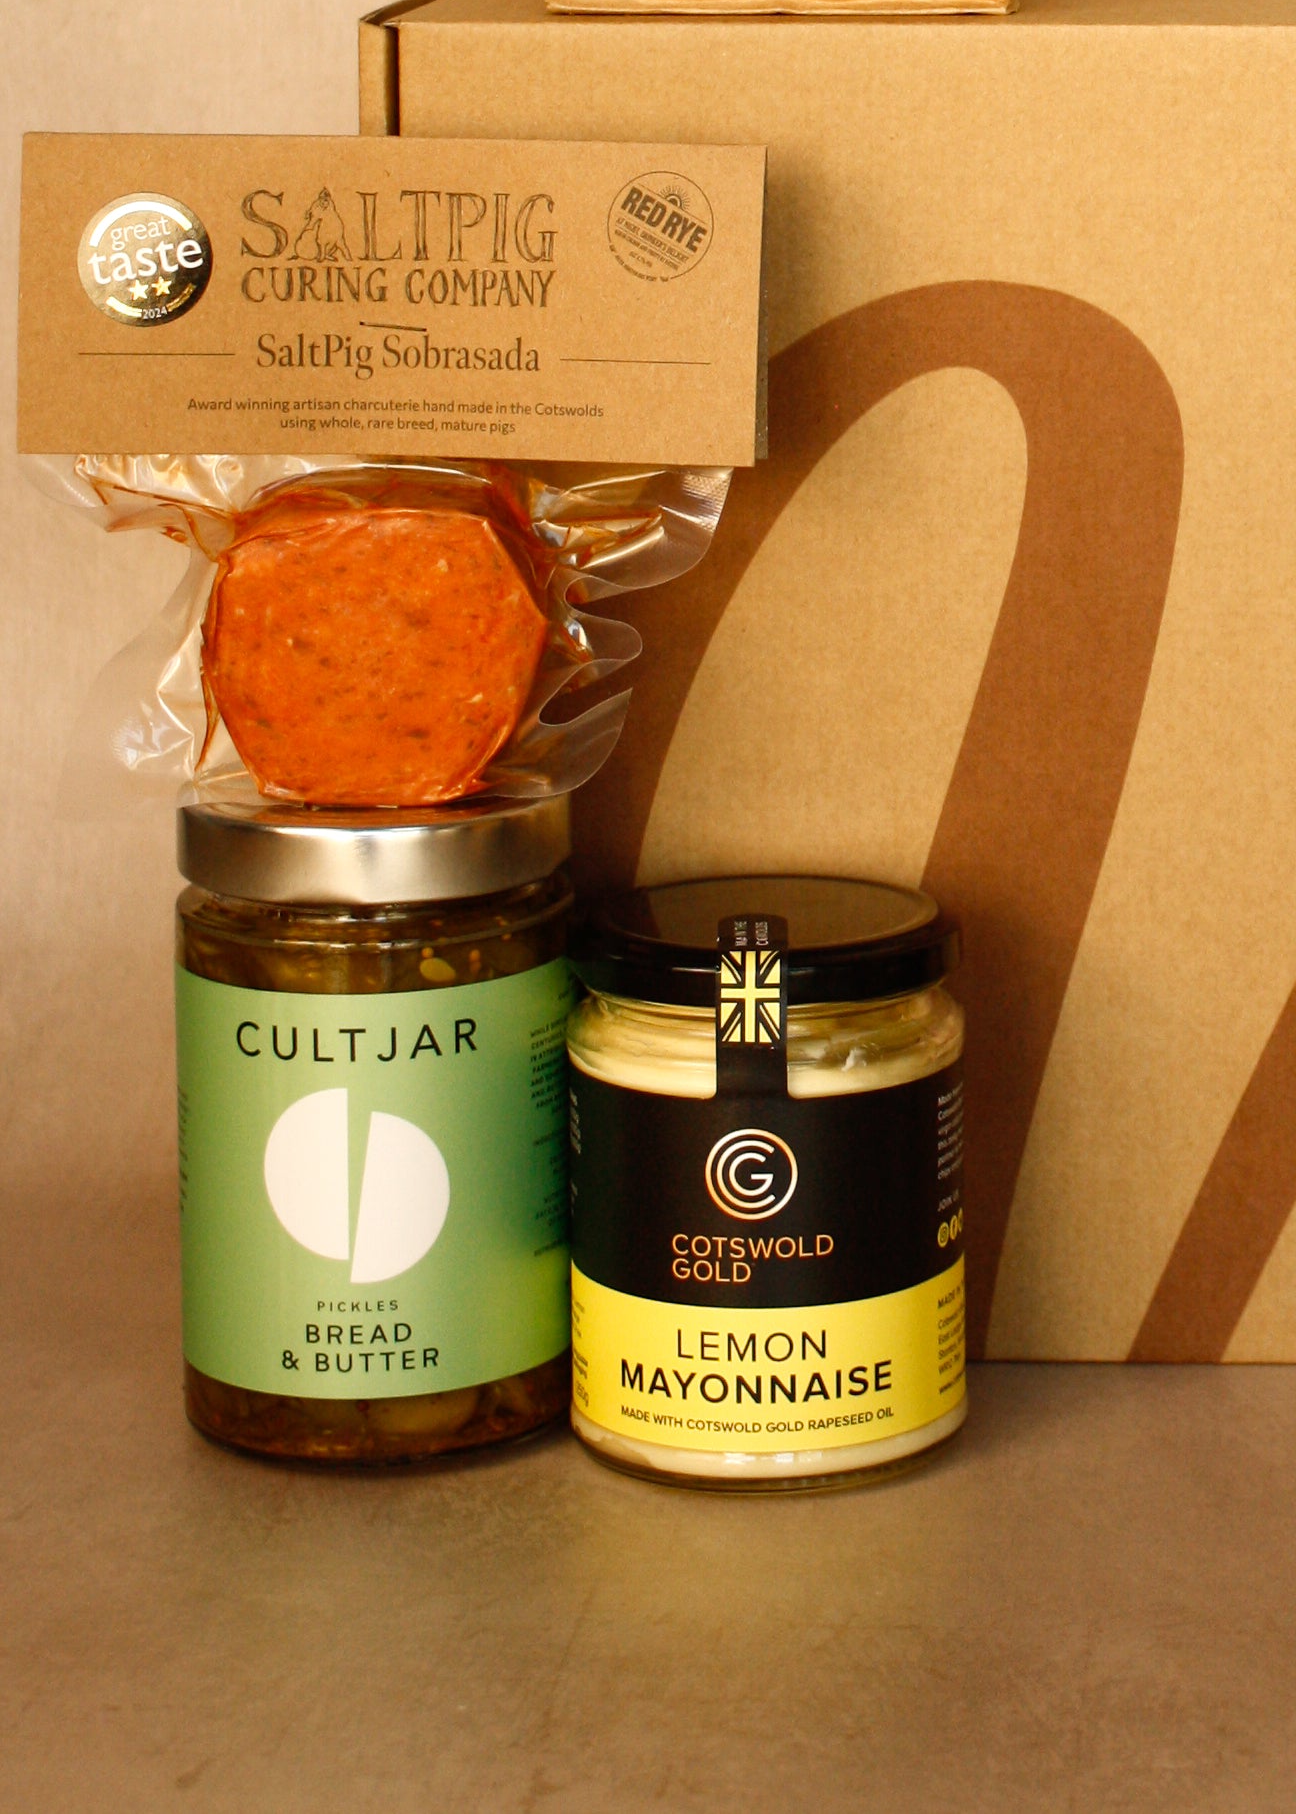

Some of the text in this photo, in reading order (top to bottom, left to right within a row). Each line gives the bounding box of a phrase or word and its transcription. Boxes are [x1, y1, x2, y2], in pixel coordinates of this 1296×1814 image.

[110, 216, 171, 251] great
[621, 186, 667, 227] RED
[661, 210, 707, 253] RYE
[87, 239, 204, 285] taste
[241, 266, 557, 308] CURING COMPANY
[142, 306, 168, 320] 2024
[257, 332, 541, 381] SaltPig Sobrasada
[187, 398, 604, 417] Award winning artisan charcuterie hand made in the Cotswolds
[280, 417, 516, 435] using whole, rare breed, mature pigs
[236, 1018, 478, 1062] CULTJAR
[672, 1233, 834, 1259] COTSWOLD
[672, 1258, 751, 1282] GOLD
[317, 1299, 399, 1312] PICKLES
[306, 1322, 412, 1344] BREAD
[677, 1329, 826, 1362] LEMON
[281, 1347, 439, 1373] & BUTTER
[621, 1358, 892, 1404] MAYONNAISE
[621, 1405, 894, 1433] MADE WITH COTSWOLD GOLD RAPESEED OIL
